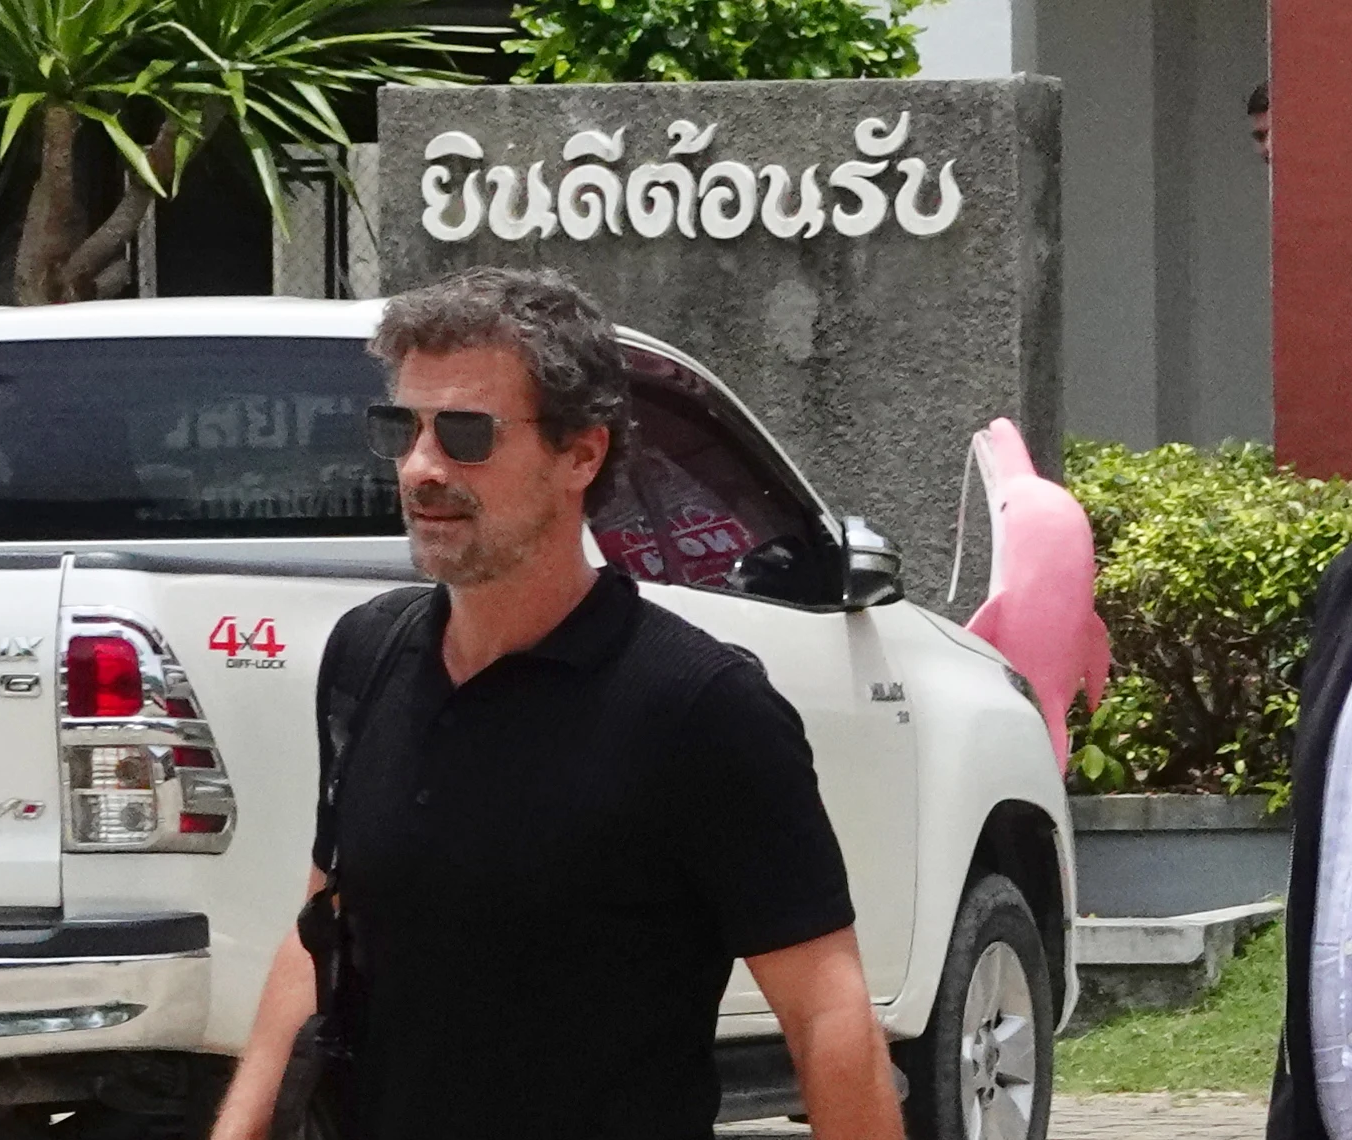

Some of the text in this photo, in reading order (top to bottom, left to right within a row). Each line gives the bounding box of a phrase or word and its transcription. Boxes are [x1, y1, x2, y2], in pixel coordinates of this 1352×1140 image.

[420, 110, 964, 241] ยินดีต้อนรับ
